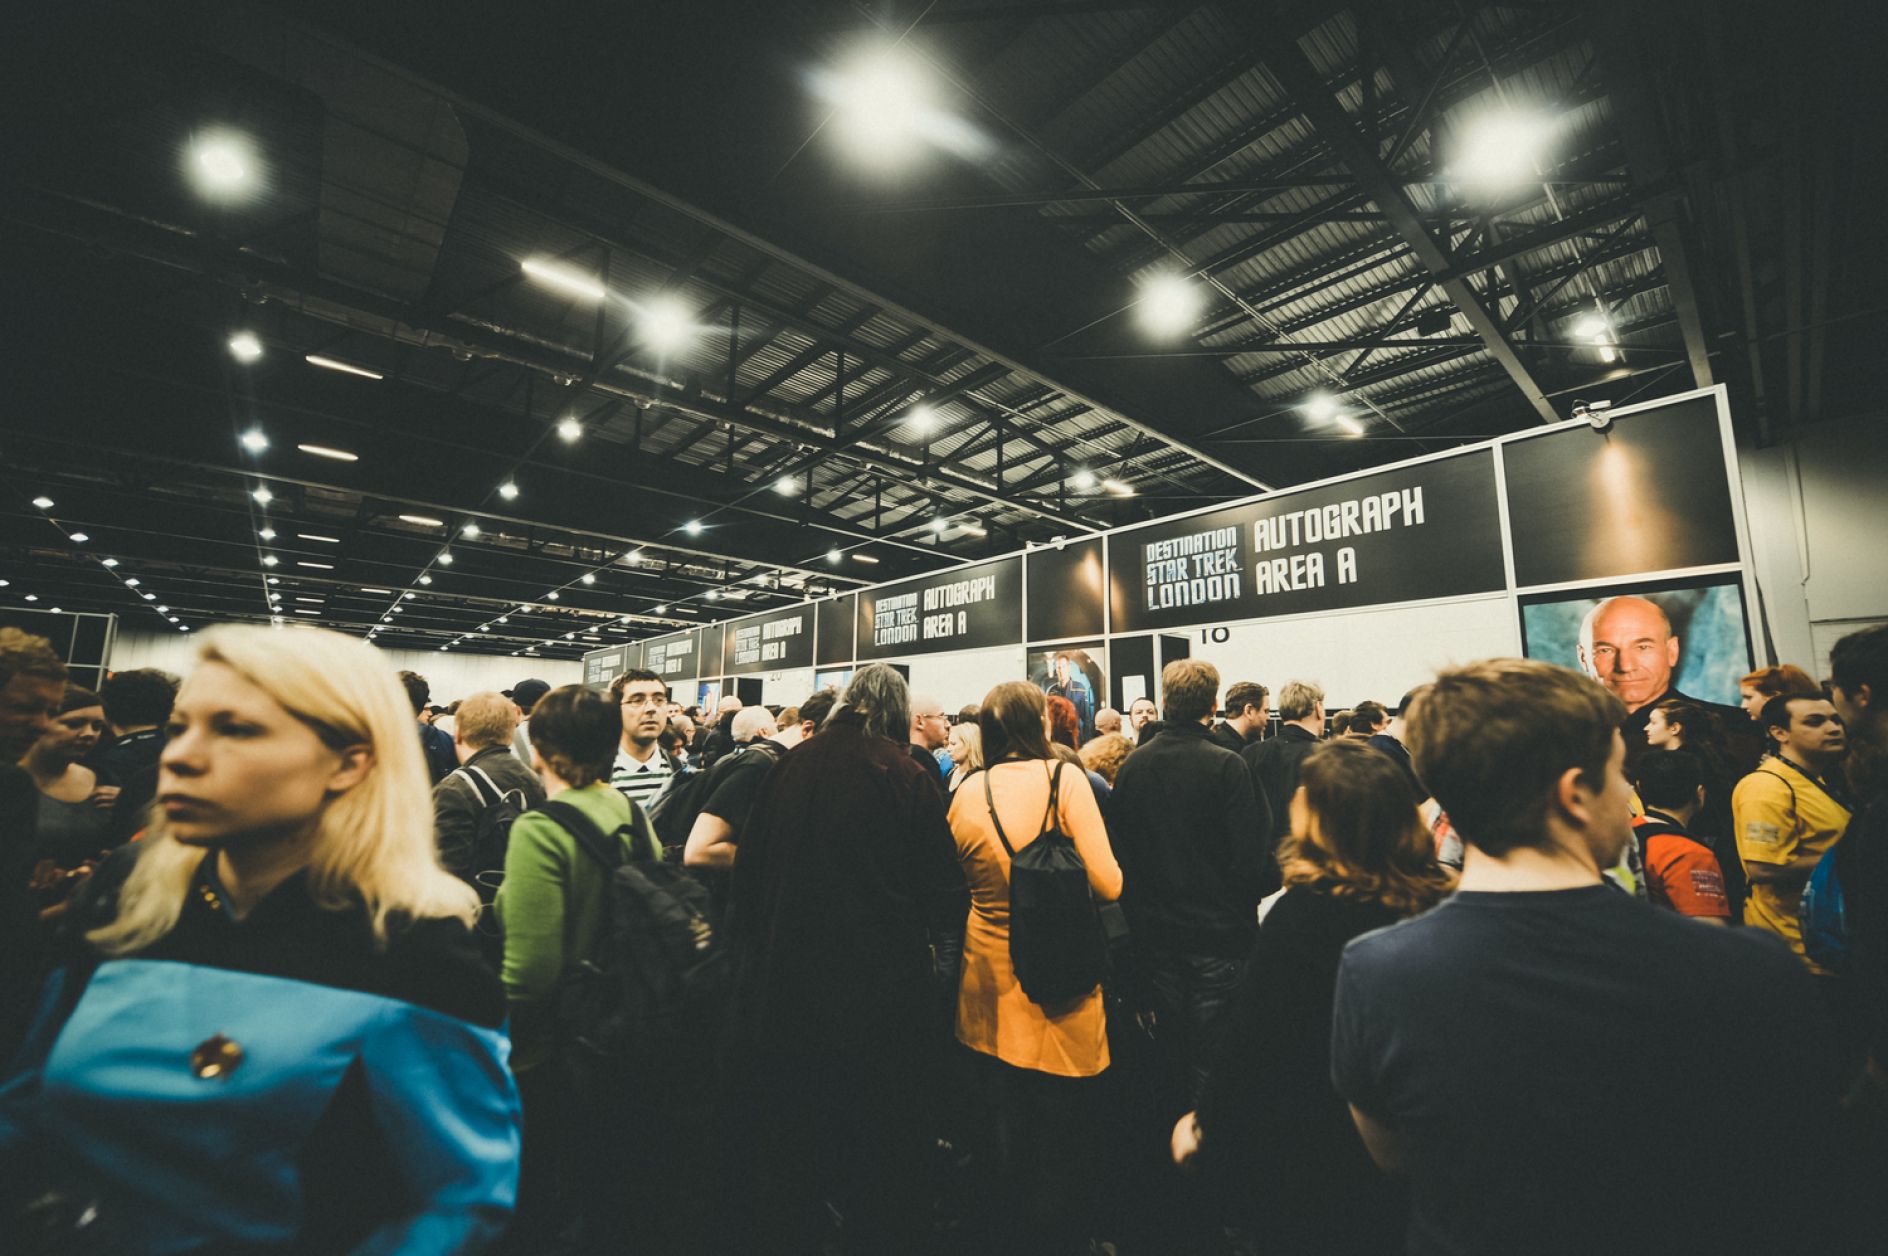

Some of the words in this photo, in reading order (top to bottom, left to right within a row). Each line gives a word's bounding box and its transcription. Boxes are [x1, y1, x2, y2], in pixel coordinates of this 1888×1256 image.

[1254, 486, 1425, 553] AUTOGRAPH
[1146, 526, 1237, 563] DESTINATION
[1146, 557, 1189, 586] STAR
[1192, 547, 1242, 578] TREK
[1255, 551, 1325, 595] AREA
[1337, 546, 1358, 585] A
[923, 575, 995, 612] AUTOGRAPH
[1147, 573, 1241, 611] LONDON
[874, 623, 918, 646] LONDON
[923, 612, 954, 639] AREA
[957, 610, 967, 635] A
